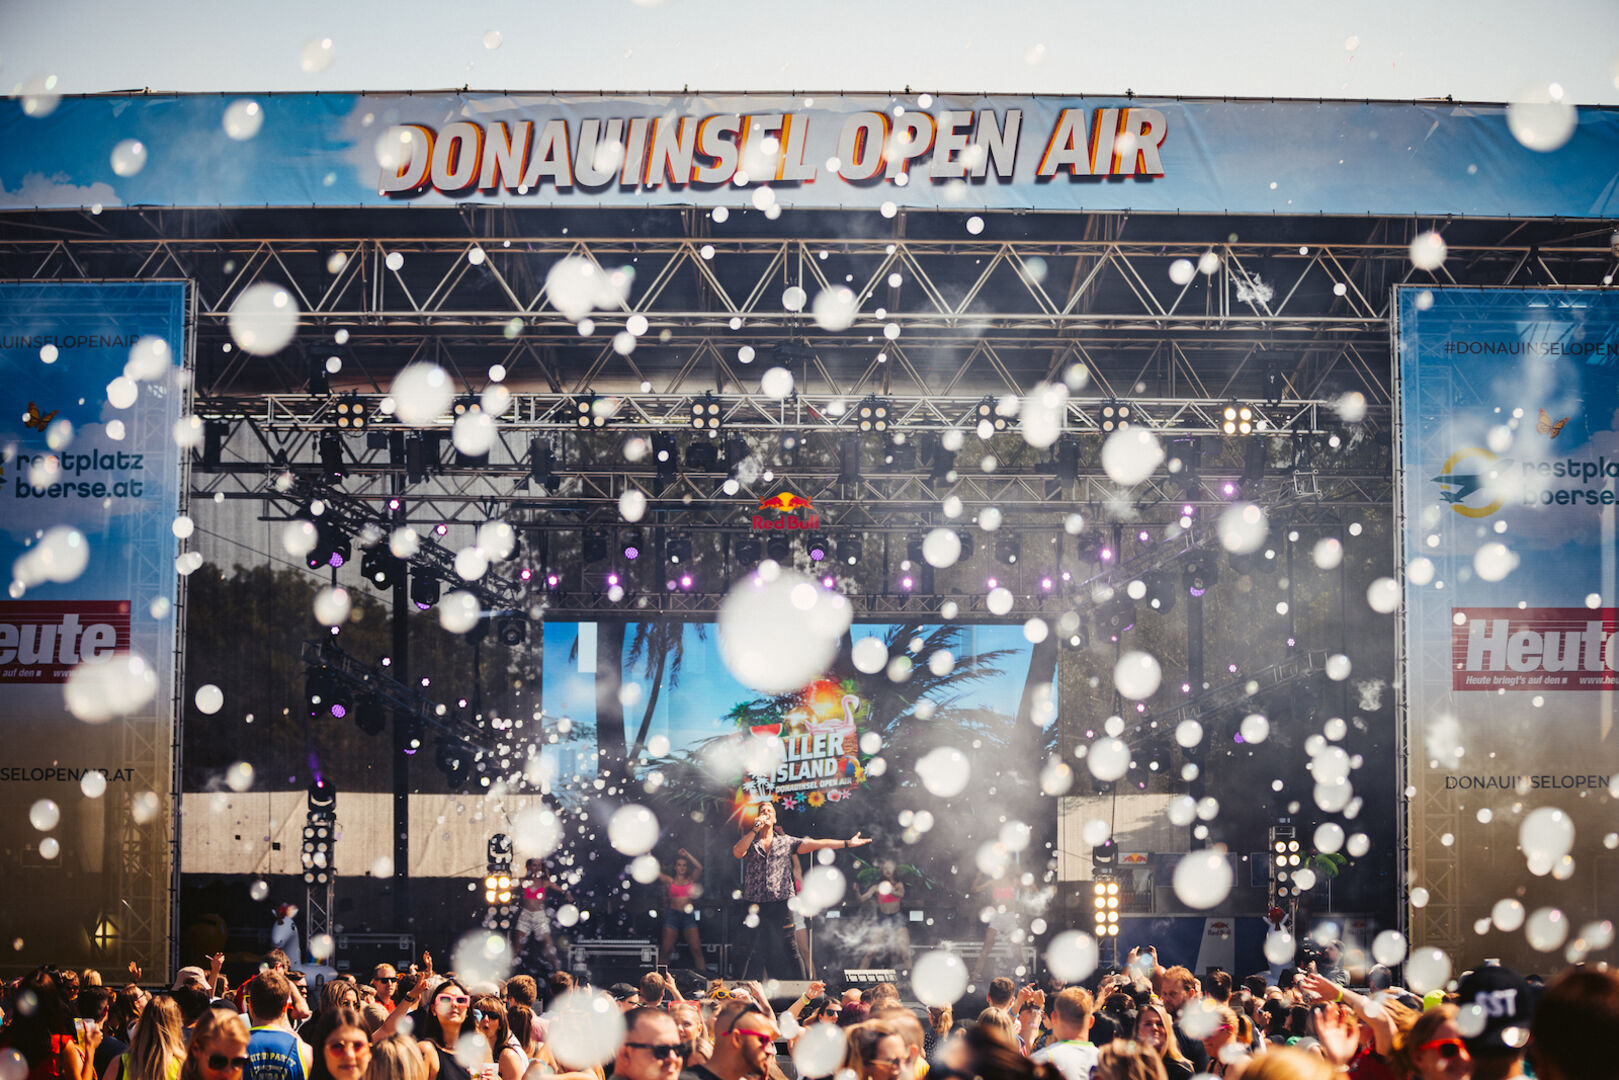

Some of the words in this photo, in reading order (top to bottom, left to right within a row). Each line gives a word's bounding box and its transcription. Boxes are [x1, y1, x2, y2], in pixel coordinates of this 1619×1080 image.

[378, 113, 817, 196] DONAUINSEL
[837, 109, 1022, 184] OPEN
[1035, 107, 1168, 184] AIR
[0, 334, 141, 349] UINSELOPENAIR
[16, 448, 144, 476] retplatz
[752, 515, 785, 530] Red
[787, 515, 819, 530] Bull
[2, 669, 17, 677] auf
[18, 669, 35, 677] den
[1466, 675, 1491, 685] Heute
[1528, 675, 1543, 685] auf
[1544, 675, 1560, 685] den
[778, 732, 844, 763] ALLER
[769, 757, 838, 784] ISLAND
